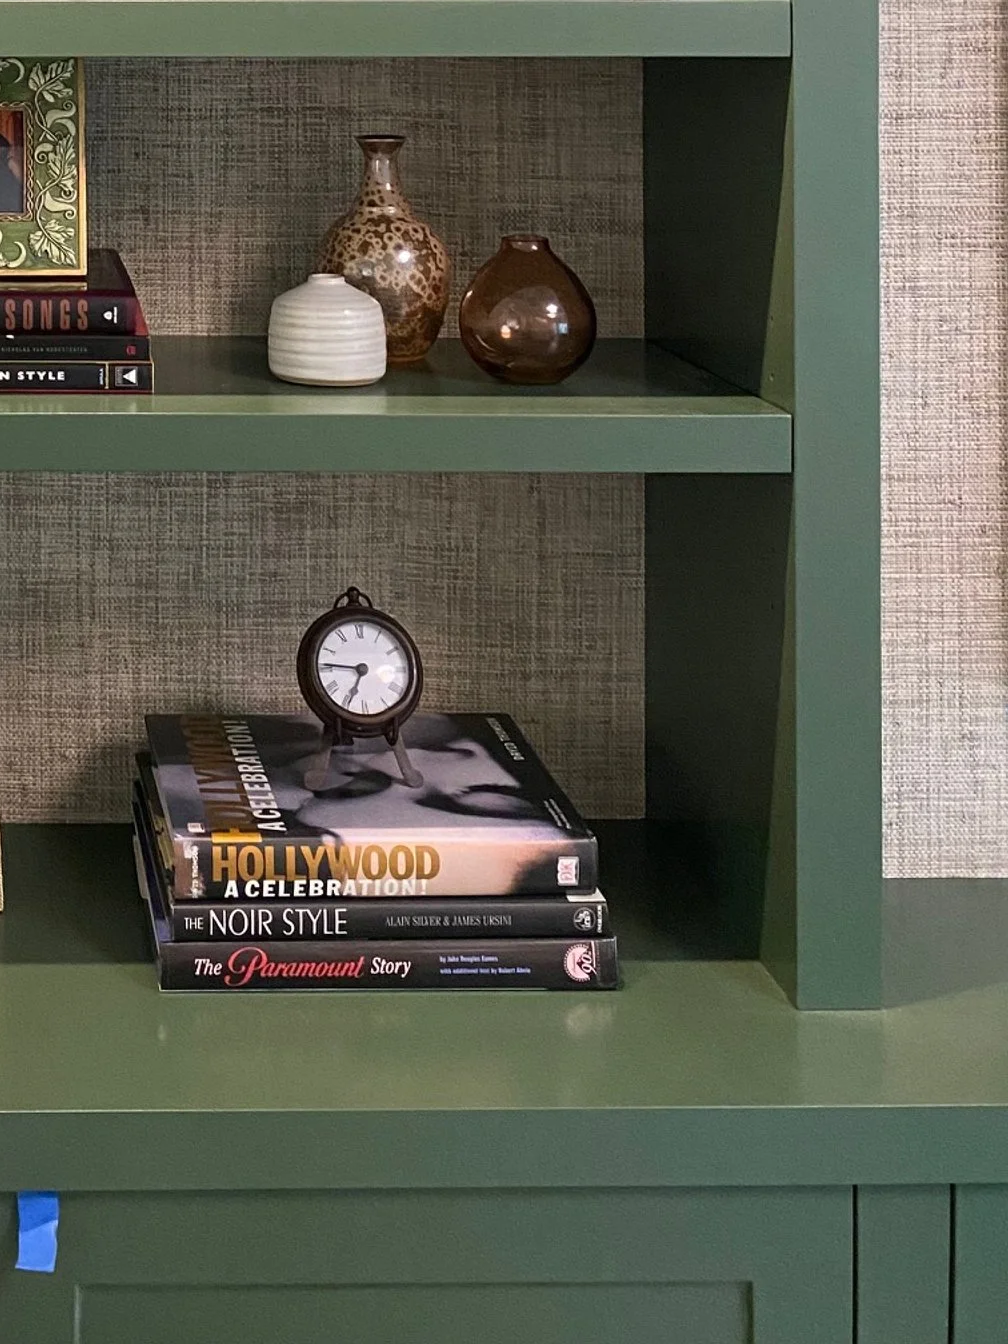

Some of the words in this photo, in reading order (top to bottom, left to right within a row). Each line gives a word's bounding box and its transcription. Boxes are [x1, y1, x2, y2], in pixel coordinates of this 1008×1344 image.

[5, 298, 88, 330] SONGS
[17, 371, 65, 381] STYLE
[222, 720, 282, 820] CELEBRATION!
[256, 822, 287, 832] A
[212, 844, 440, 882] HOLLYWOOD
[224, 879, 239, 898] A
[245, 879, 428, 898] CELEBRATION!
[184, 918, 203, 930] THE
[209, 908, 273, 936] NOIR
[282, 908, 348, 936] STYLE
[385, 917, 411, 927] ALAIN
[413, 916, 442, 927] SILVER
[443, 916, 450, 926] &
[452, 916, 482, 926] JAMES
[483, 915, 512, 926] URSINI
[194, 958, 223, 976] The
[224, 946, 365, 987] Paramount
[371, 957, 412, 978] Story
